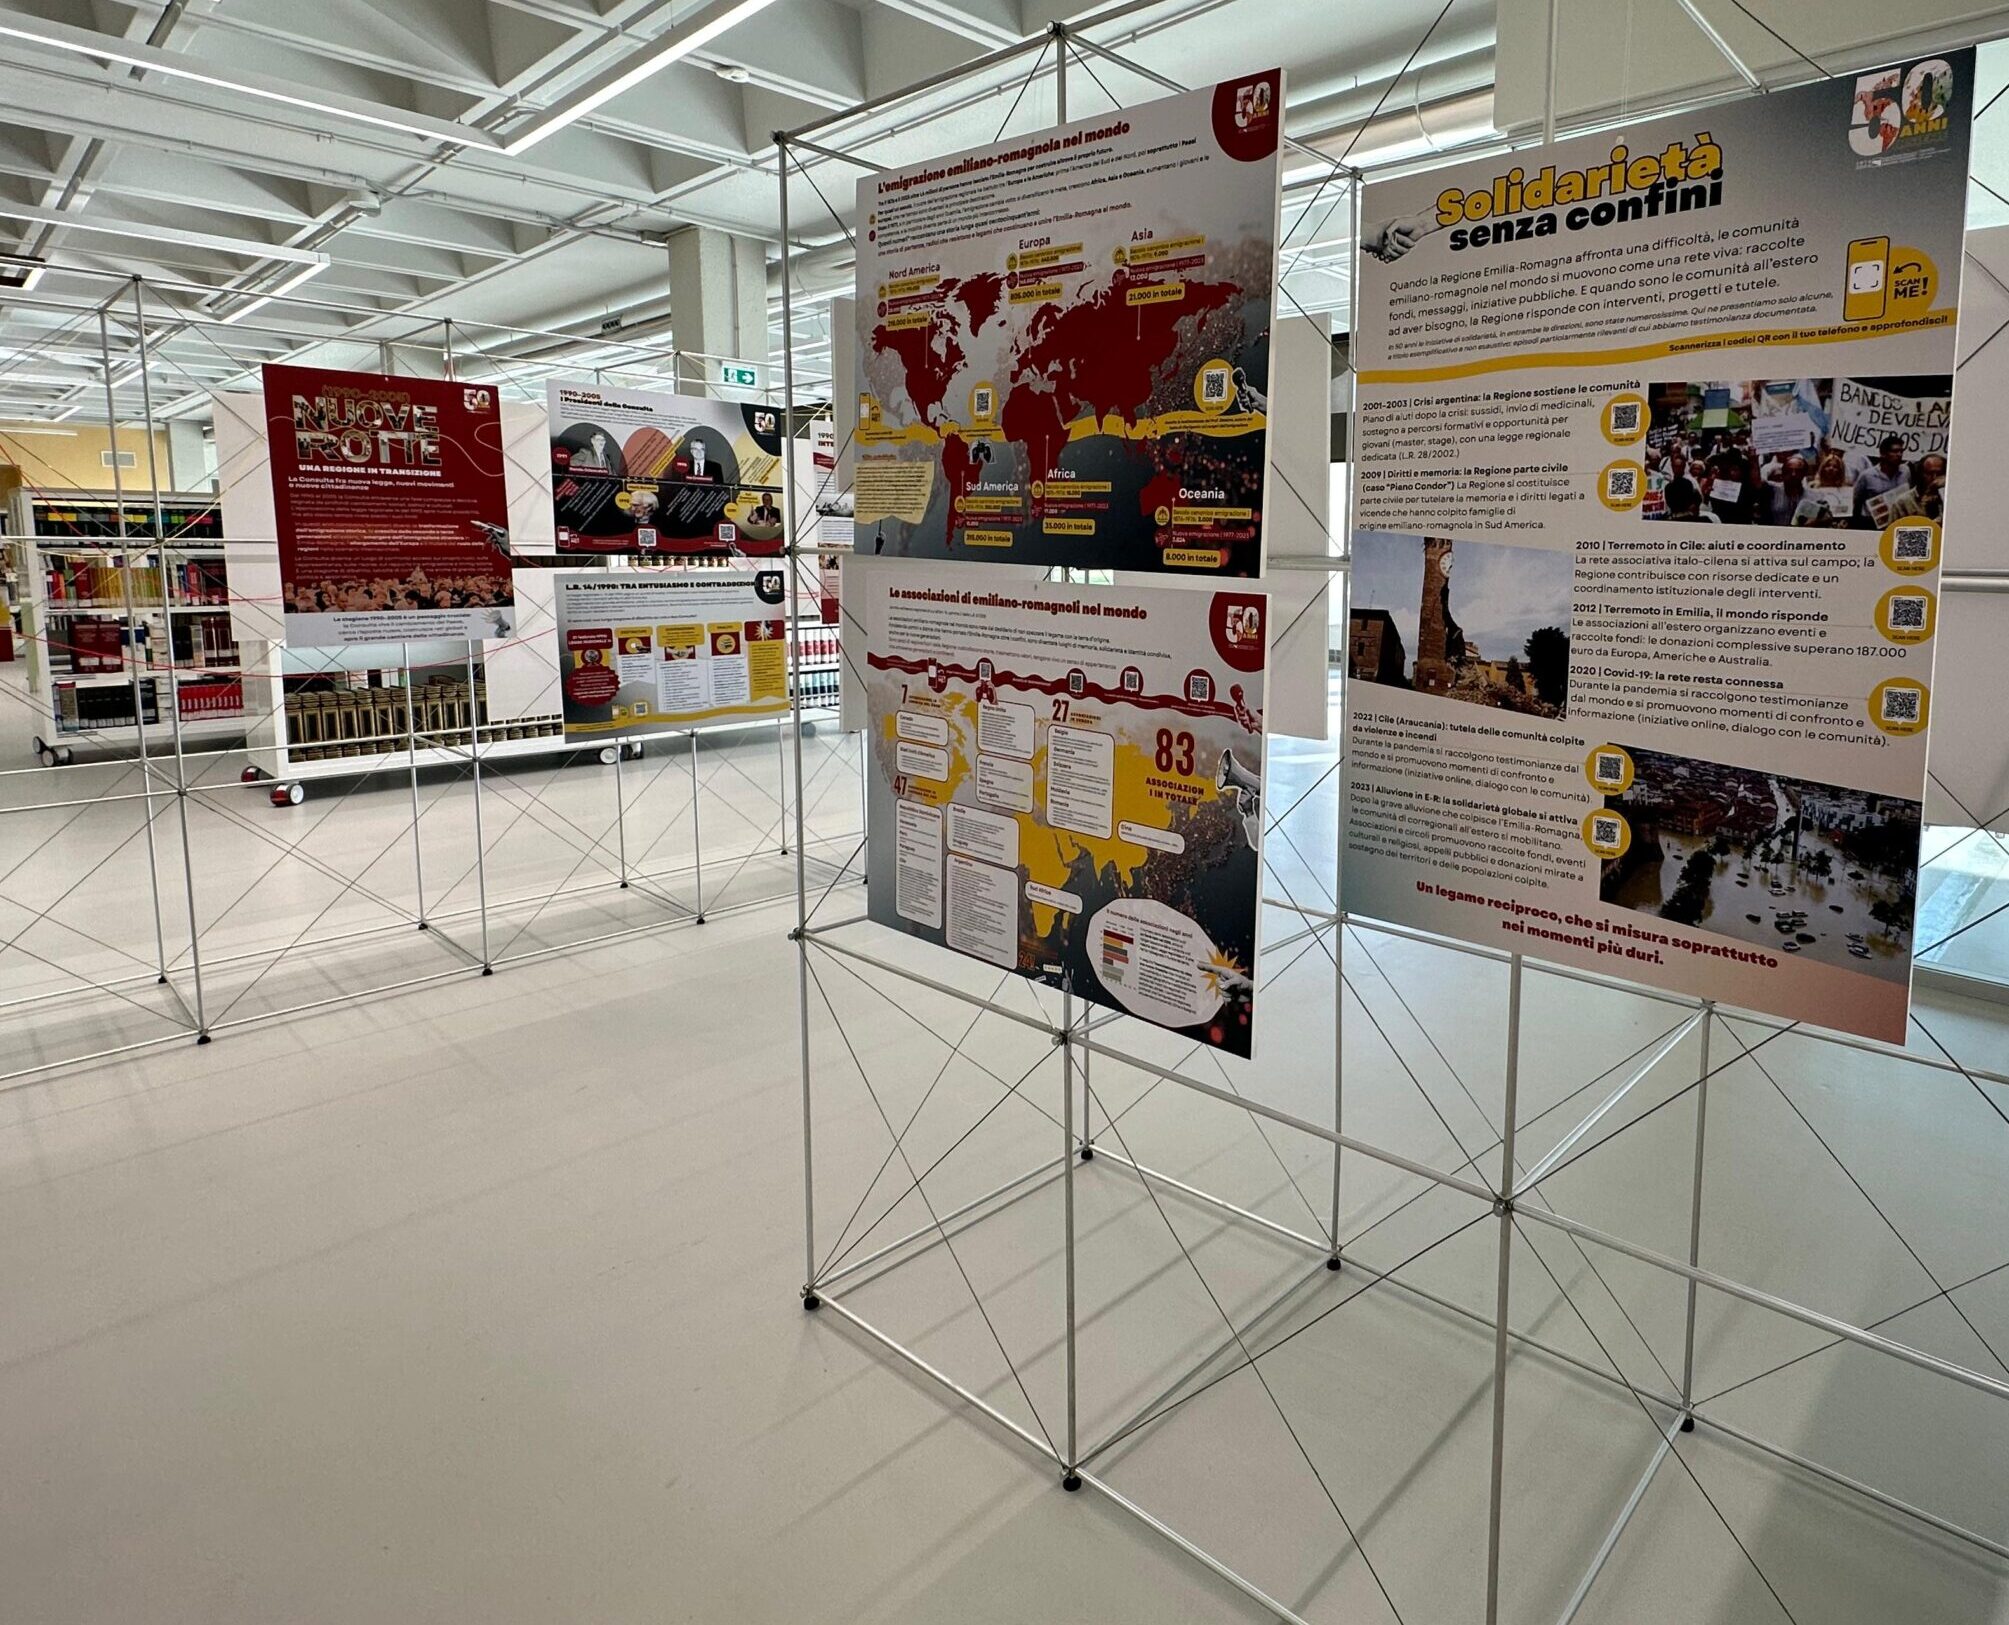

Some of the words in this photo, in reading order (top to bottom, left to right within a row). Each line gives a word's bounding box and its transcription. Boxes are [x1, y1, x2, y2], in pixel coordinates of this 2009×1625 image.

[1235, 82, 1271, 127] 50
[1848, 59, 1953, 156] 50
[1900, 117, 1948, 137] ANNI
[878, 168, 945, 194] L'emigrazione
[946, 138, 1060, 176] emiliano-romagnola
[1062, 130, 1082, 148] nel
[1084, 120, 1129, 143] mondo
[1435, 131, 1722, 227] Solidarietà
[1449, 211, 1558, 251] senza
[1565, 168, 1724, 231] confini
[1018, 236, 1050, 250] Europa
[1131, 228, 1153, 242] Asia
[1389, 277, 1427, 292] Quando
[1429, 275, 1438, 284] la
[1440, 270, 1481, 283] Regione
[1483, 256, 1572, 276] Emilia-Romagna
[1575, 248, 1622, 262] affronta
[1626, 243, 1648, 254] una
[1652, 231, 1714, 250] difficoltà,
[1717, 229, 1729, 240] le
[1732, 216, 1799, 237] comunità
[889, 268, 907, 280] Nord
[908, 264, 940, 276] America
[1389, 283, 1488, 306] emiliano-romagnole
[1490, 280, 1506, 291] nel
[1509, 274, 1548, 288] mondo
[1550, 271, 1559, 282] si
[1562, 266, 1616, 281] muovono
[1618, 260, 1654, 272] come
[1657, 256, 1680, 267] una
[1684, 252, 1710, 262] rete
[1713, 246, 1742, 258] viva:
[1746, 236, 1804, 253] raccolte
[1042, 286, 1060, 296] totale
[1894, 276, 1920, 288] SCAN
[1129, 292, 1152, 301] 21.000
[1152, 290, 1160, 298] in
[1160, 288, 1182, 298] totale
[1669, 340, 1721, 351] Scannerizza
[1727, 335, 1755, 345] codici
[1757, 334, 1770, 343] QR
[1818, 326, 1859, 336] telefono
[1870, 315, 1947, 332] approfondisci!
[464, 388, 490, 410] 50
[565, 397, 602, 407] Presidenti
[604, 400, 622, 409] della
[622, 402, 653, 412] Consulta
[1362, 399, 1407, 410] 2001-2003
[1413, 396, 1433, 406] Crisi
[1435, 393, 1480, 406] argentina:
[1482, 392, 1490, 400] la
[1493, 389, 1531, 401] Regione
[1533, 385, 1576, 396] sostiene
[1578, 384, 1587, 393] le
[1589, 379, 1640, 392] comunità
[292, 394, 440, 432] NUOVE
[754, 412, 776, 432] 50
[294, 429, 442, 466] ROTTE
[299, 464, 320, 472] UNA
[322, 466, 365, 474] REGIONE
[367, 466, 378, 474] IN
[379, 468, 442, 476] TRANSIZIONE
[1048, 468, 1076, 479] Africa
[966, 480, 982, 492] Sud
[984, 480, 1018, 492] America
[1179, 487, 1224, 499] Oceania
[1045, 522, 1066, 530] 35.000
[1074, 522, 1092, 531] totale
[994, 534, 1010, 542] totale
[1575, 540, 1600, 549] 2010
[1607, 541, 1664, 550] Terremoto
[1666, 540, 1677, 550] in
[1679, 540, 1705, 550] Cile:
[1707, 539, 1734, 550] aiuti
[1746, 539, 1845, 550] coordinamento
[1166, 552, 1186, 562] 8.000
[1187, 554, 1194, 562] in
[1196, 554, 1218, 563] totale
[620, 582, 638, 590] TRA
[889, 587, 899, 598] Le
[901, 588, 959, 603] associazioni
[961, 591, 970, 604] di
[972, 592, 1080, 615] emiliano-romagnoli
[1082, 602, 1100, 615] nel
[1103, 605, 1146, 619] mondo
[1572, 603, 1596, 612] 2012
[1603, 604, 1660, 615] Terremoto
[1662, 605, 1673, 615] in
[1676, 607, 1713, 618] Emilia,
[1716, 607, 1722, 617] il
[1725, 609, 1768, 619] mondo
[1771, 609, 1828, 622] risponde
[1226, 606, 1259, 642] 50
[1568, 664, 1596, 675] 2020
[1603, 667, 1652, 679] Covid-19:
[1655, 670, 1664, 680] la
[1667, 673, 1690, 682] rete
[1692, 676, 1722, 684] resta
[1724, 678, 1783, 689] connessa
[902, 684, 908, 704] 7
[1052, 698, 1070, 722] 27
[1155, 728, 1194, 776] 83
[894, 775, 908, 796] 47
[1146, 777, 1204, 796] ASSOCIAZION
[1154, 790, 1164, 798] IN
[1165, 792, 1198, 806] TOTALE
[1416, 880, 1432, 893] Un
[1436, 884, 1484, 904] legame
[1487, 898, 1561, 924] reciproco,
[1564, 914, 1592, 928] che
[1595, 918, 1609, 932] si
[1612, 923, 1668, 944] misura
[1671, 938, 1777, 967] soprattutto
[1502, 920, 1524, 932] nei
[1527, 926, 1594, 948] momenti
[1597, 940, 1622, 955] più
[1625, 946, 1663, 964] duri.
